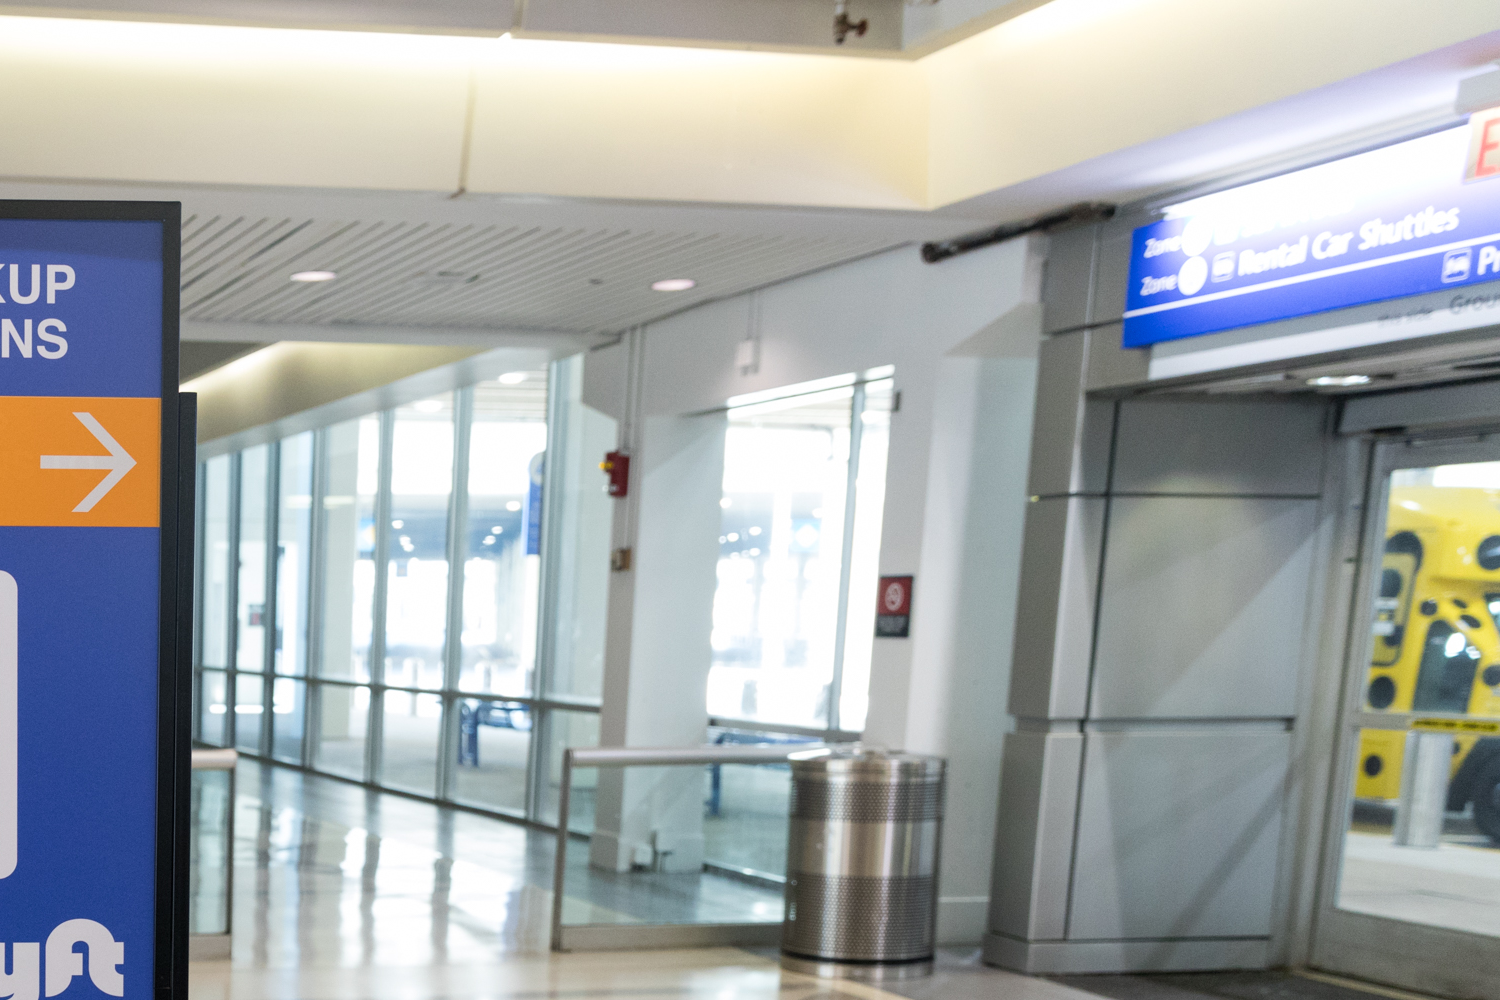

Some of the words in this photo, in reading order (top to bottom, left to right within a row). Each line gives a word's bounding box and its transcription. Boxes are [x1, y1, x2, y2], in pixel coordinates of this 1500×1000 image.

[1140, 273, 1179, 297] Zone
[1237, 235, 1309, 276] Rental
[1311, 231, 1354, 260] Car
[1358, 205, 1460, 251] Shuttles
